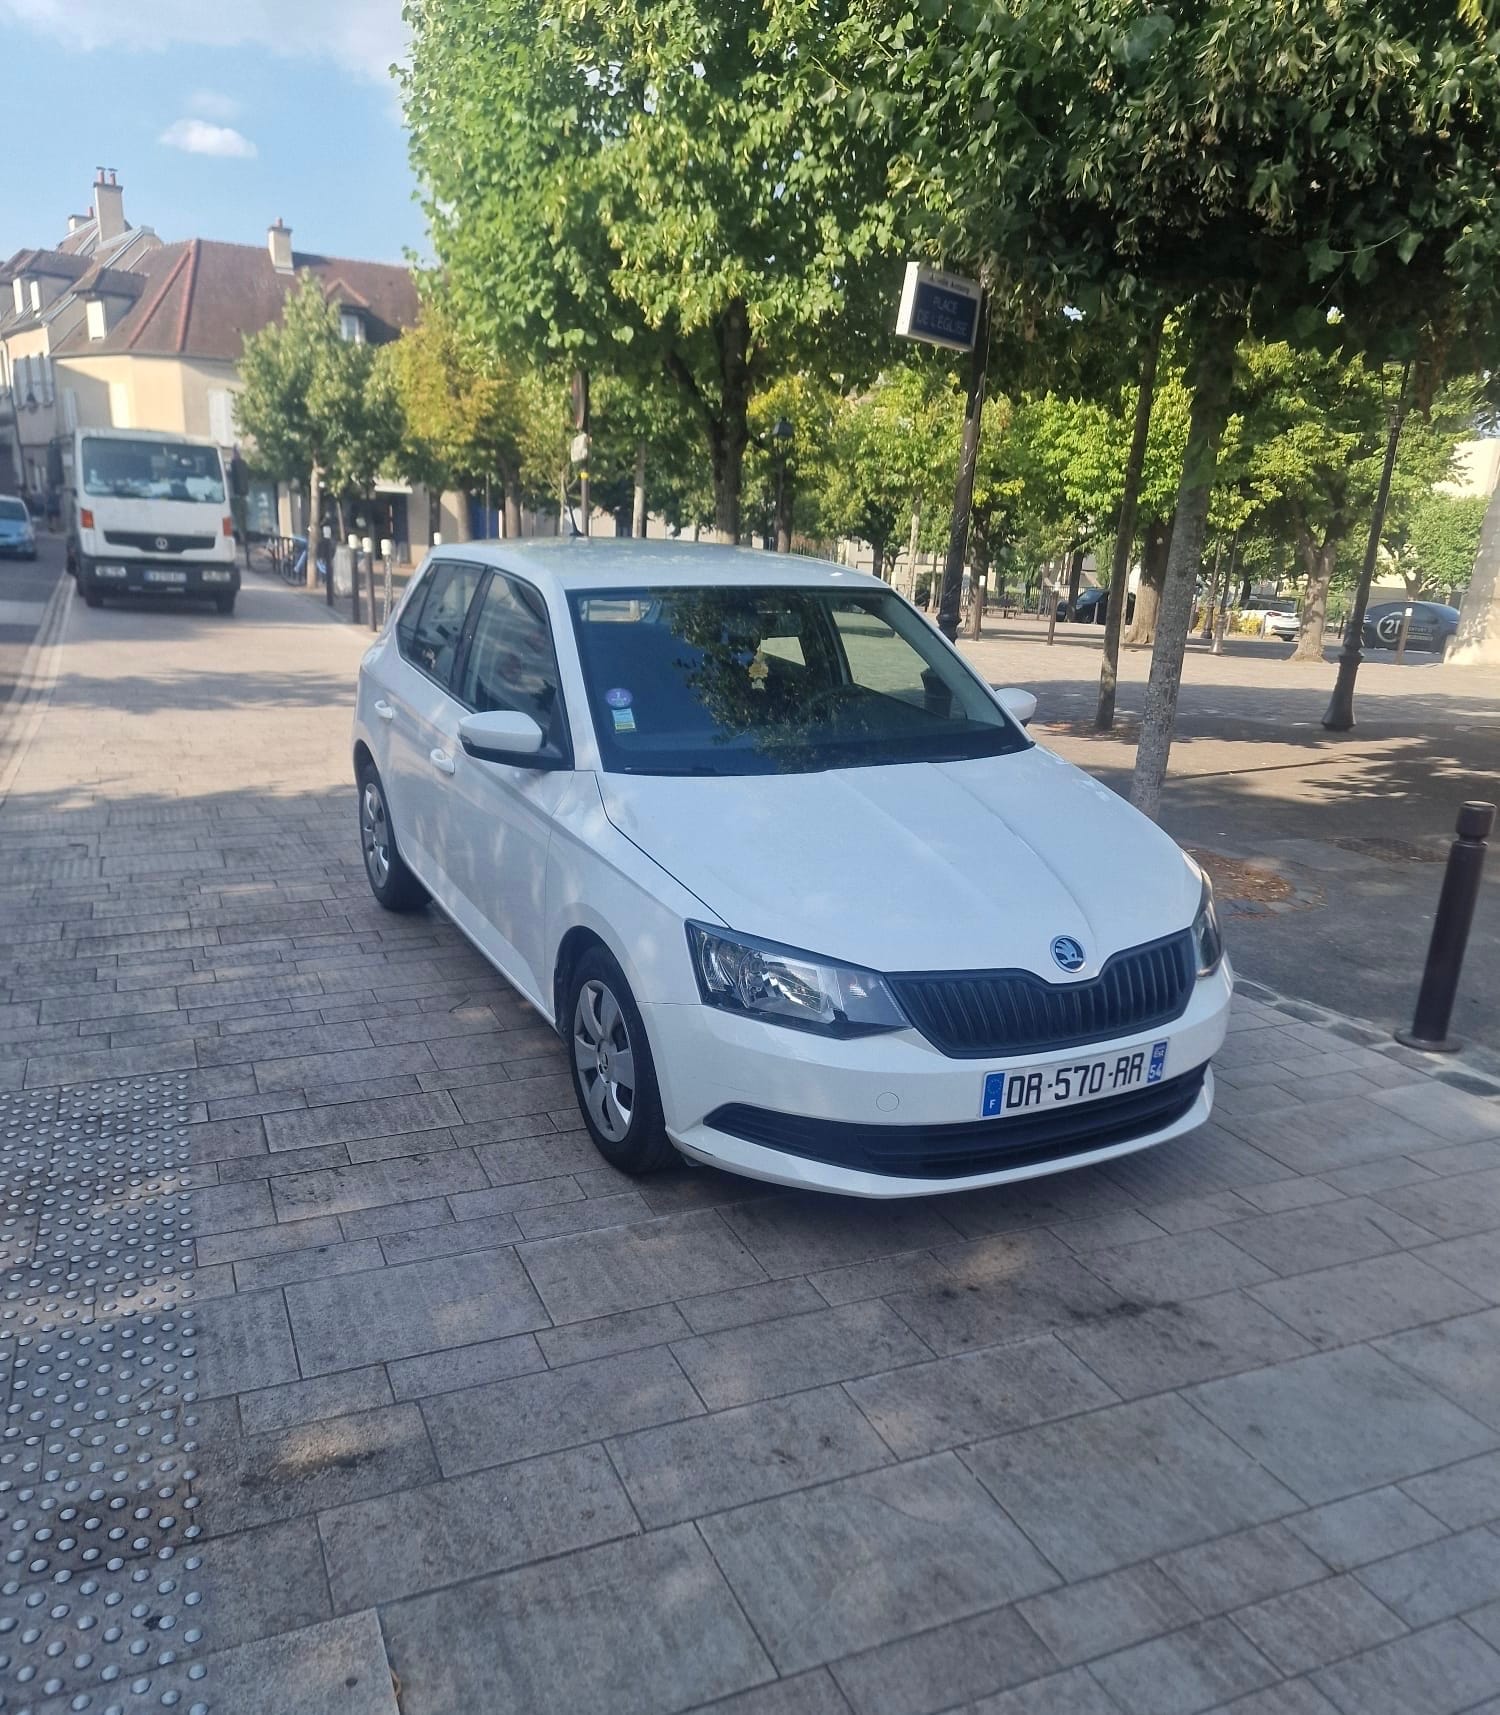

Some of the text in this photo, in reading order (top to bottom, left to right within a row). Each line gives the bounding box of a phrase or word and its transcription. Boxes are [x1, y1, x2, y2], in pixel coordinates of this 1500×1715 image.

[1384, 619, 1401, 635] 21
[1149, 1063, 1162, 1079] 54
[989, 1099, 996, 1110] F
